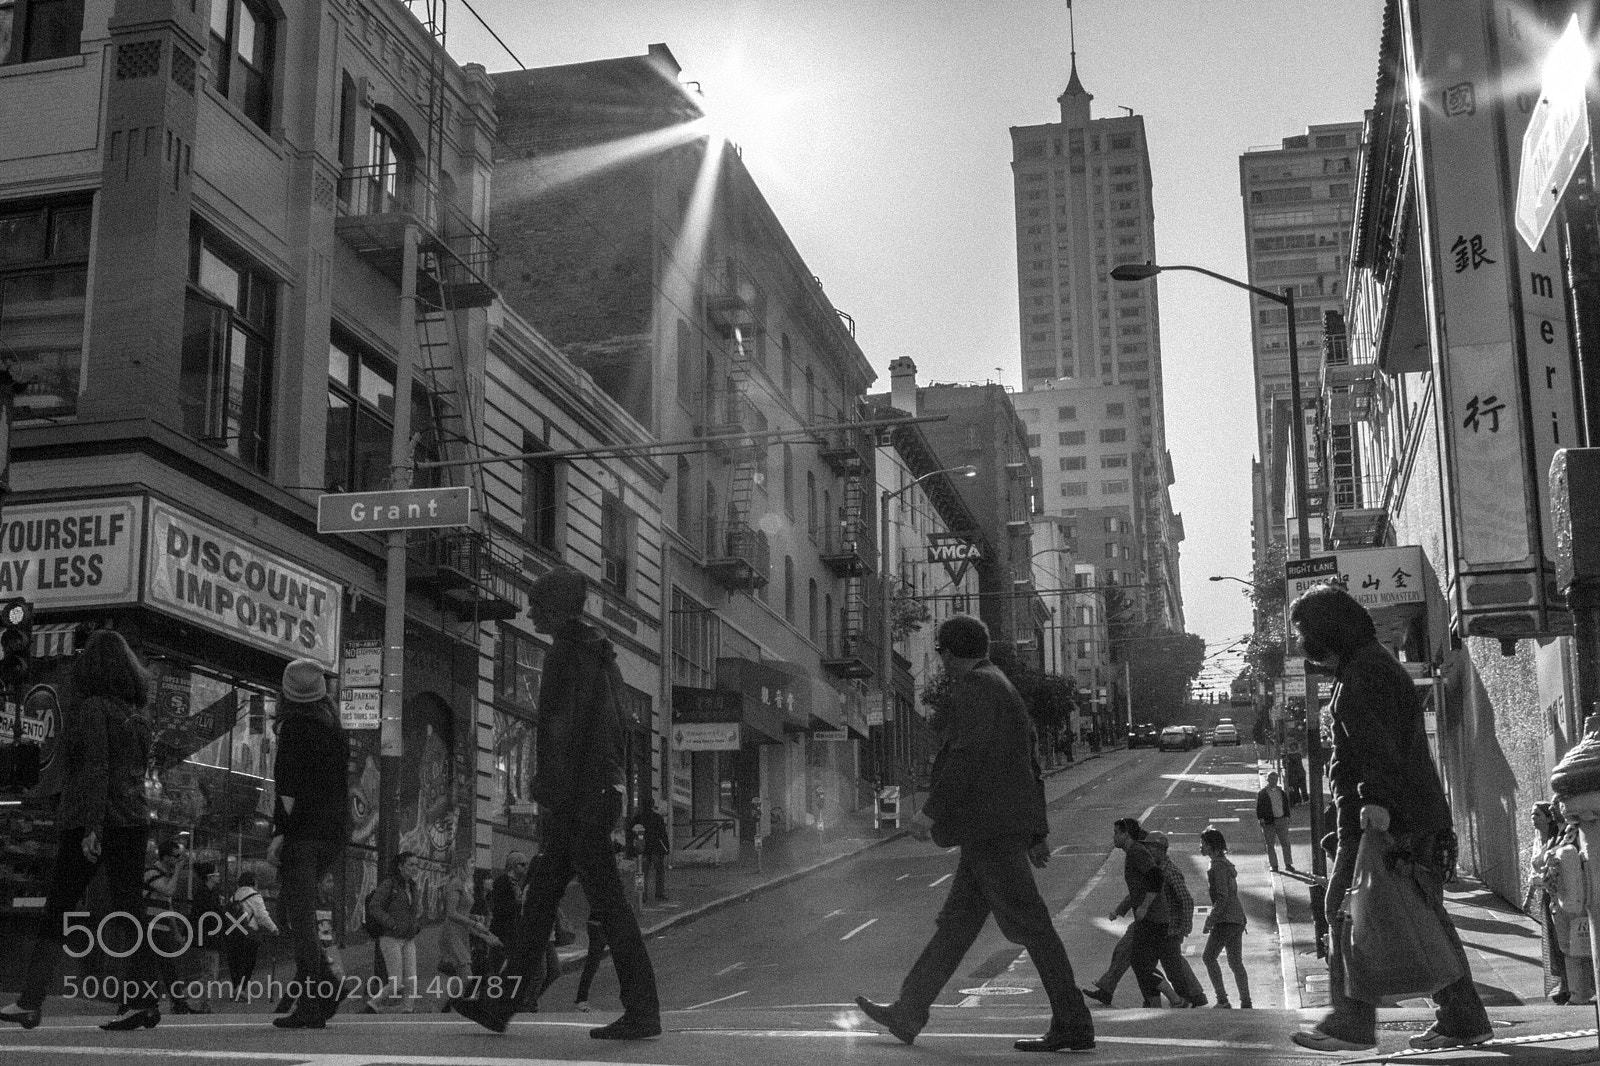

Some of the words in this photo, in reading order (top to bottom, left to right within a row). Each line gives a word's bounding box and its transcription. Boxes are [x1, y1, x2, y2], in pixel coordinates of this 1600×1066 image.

[350, 498, 438, 522] Grant
[929, 543, 982, 561] YMCA
[37, 553, 104, 590] LESS
[165, 522, 327, 617] DISCOUNT
[1288, 564, 1311, 575] RIGHT
[1313, 561, 1335, 572] LANE
[1380, 591, 1420, 603] MONASTERY
[175, 567, 317, 650] IMPORTS
[345, 648, 356, 658] NO
[341, 689, 352, 701] NO
[354, 691, 379, 701] PARKING
[2, 716, 44, 739] RAENTO
